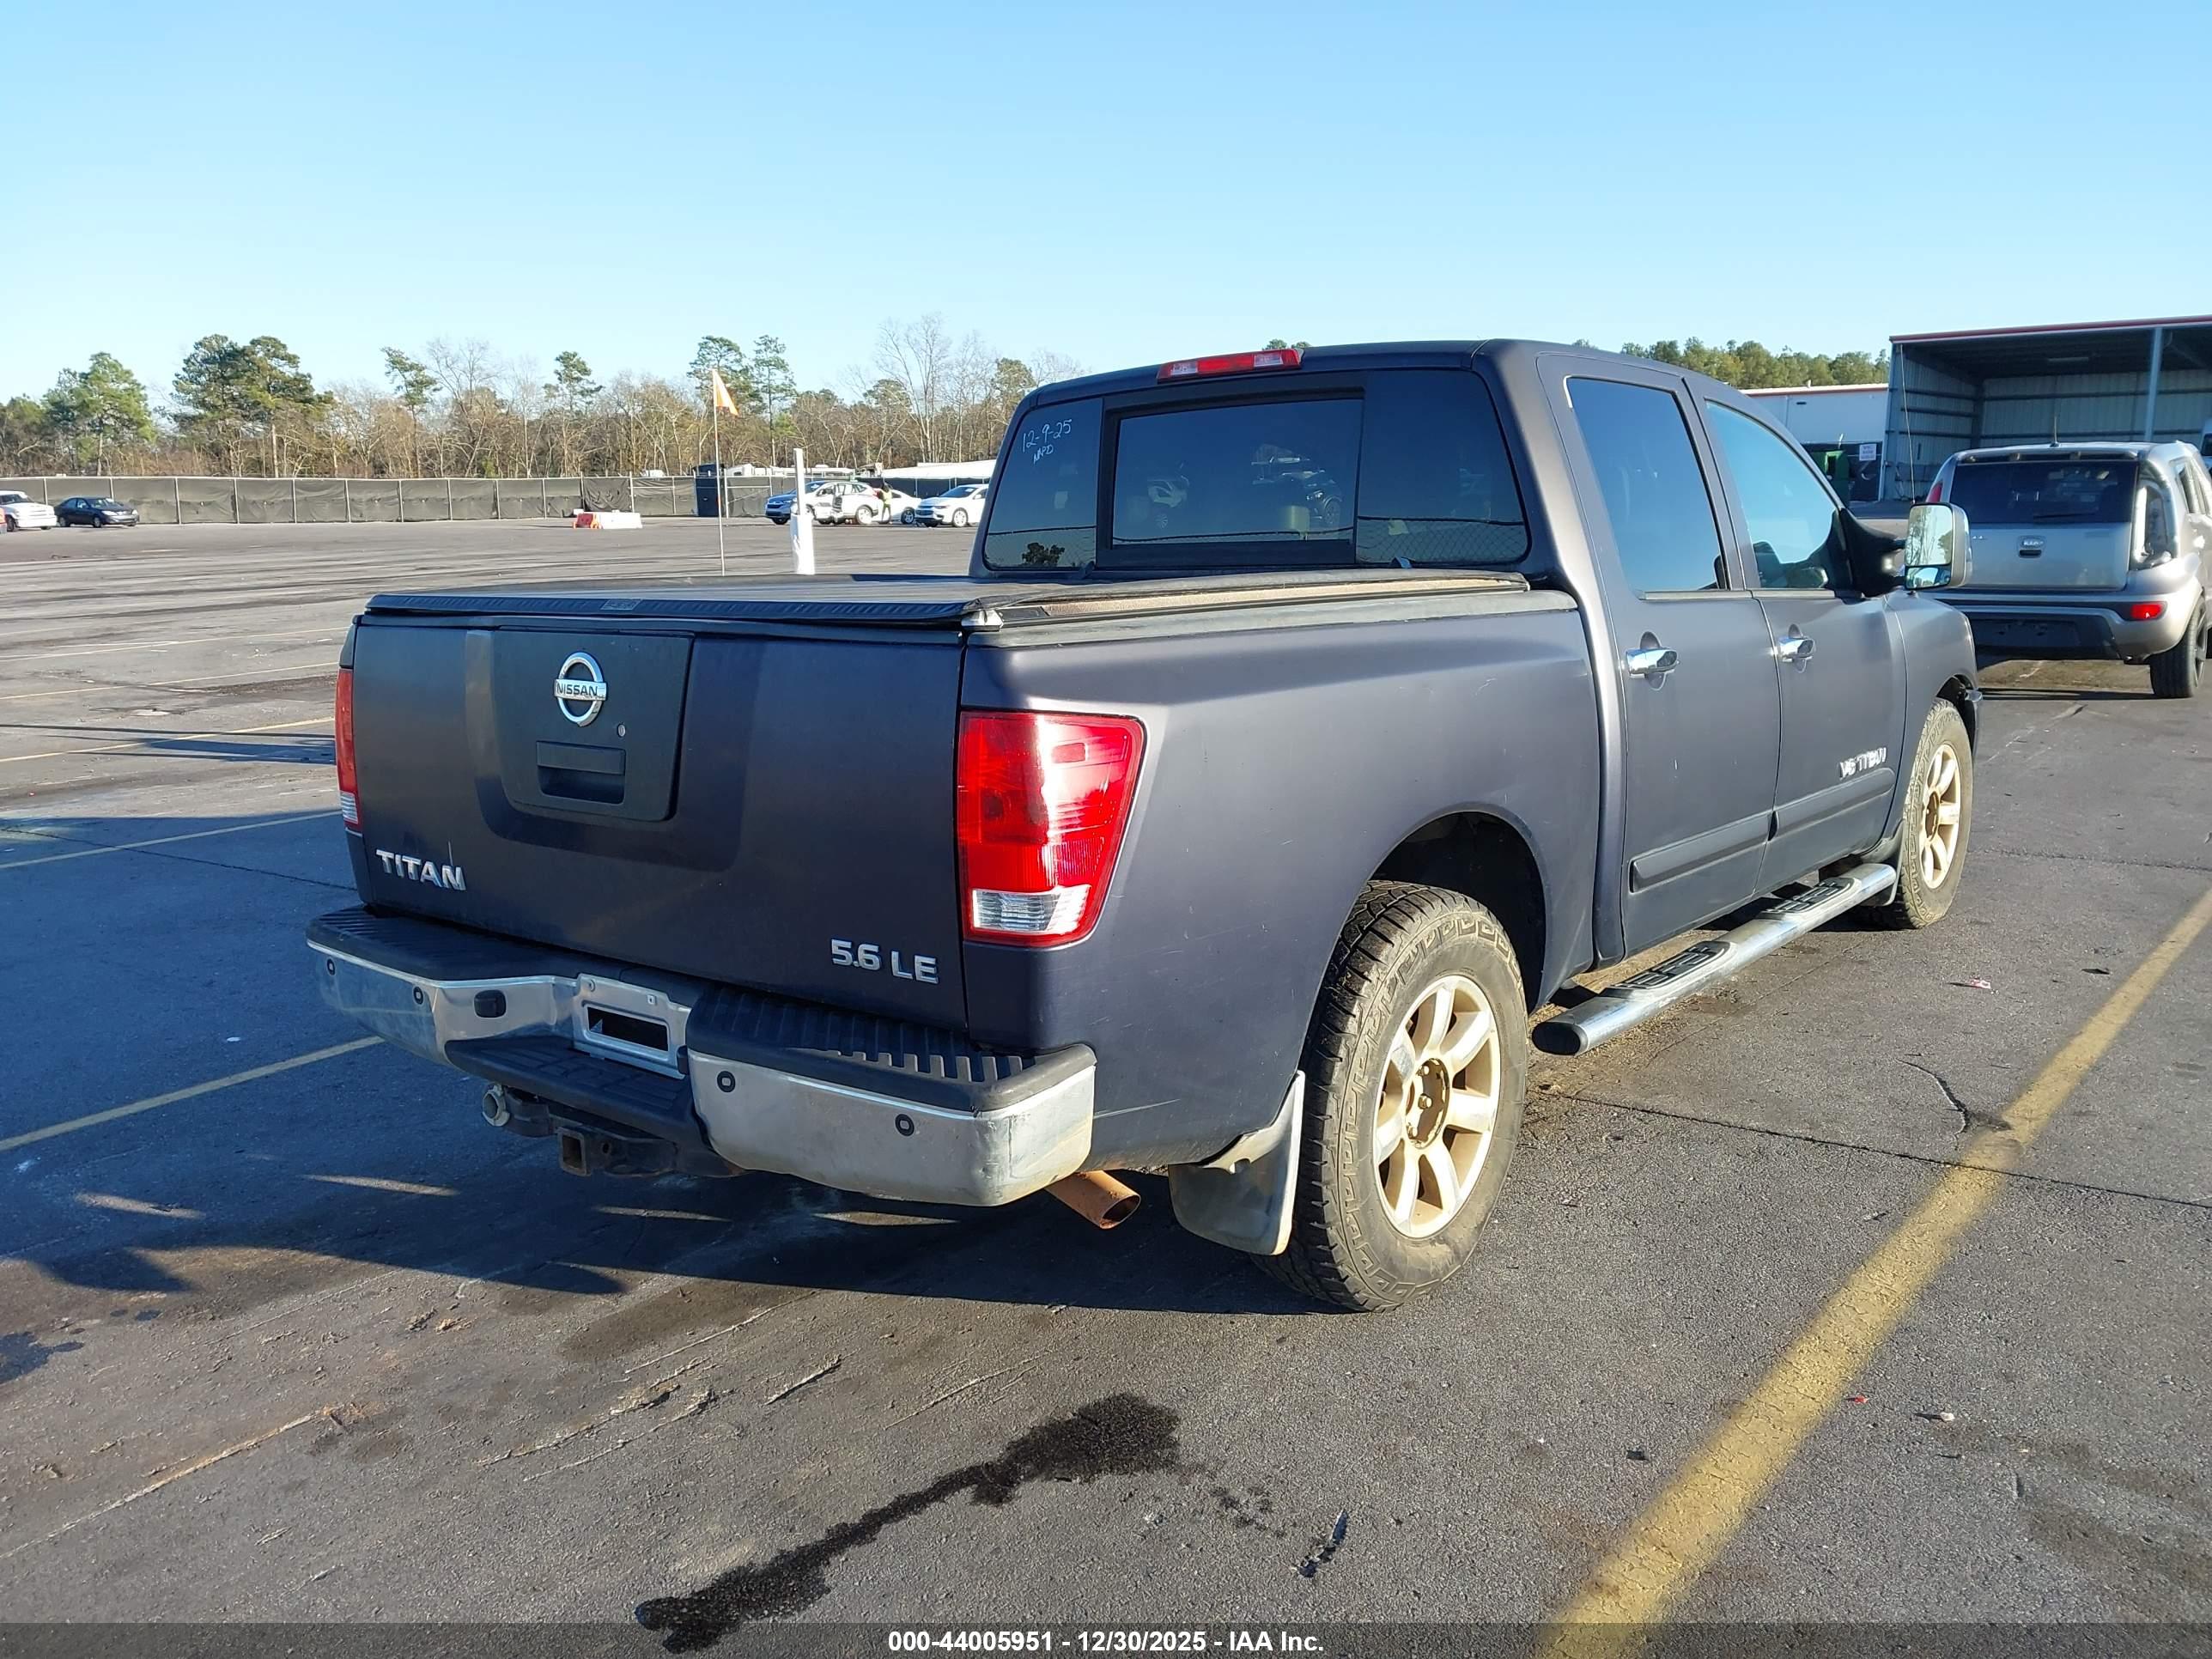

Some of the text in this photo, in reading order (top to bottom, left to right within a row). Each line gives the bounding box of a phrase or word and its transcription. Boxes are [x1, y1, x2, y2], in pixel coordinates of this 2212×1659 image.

[1022, 418, 1073, 453] 12-9-25
[556, 683, 599, 697] NISSAN
[375, 848, 466, 891] TITAN
[830, 938, 939, 985] 5.6 LE
